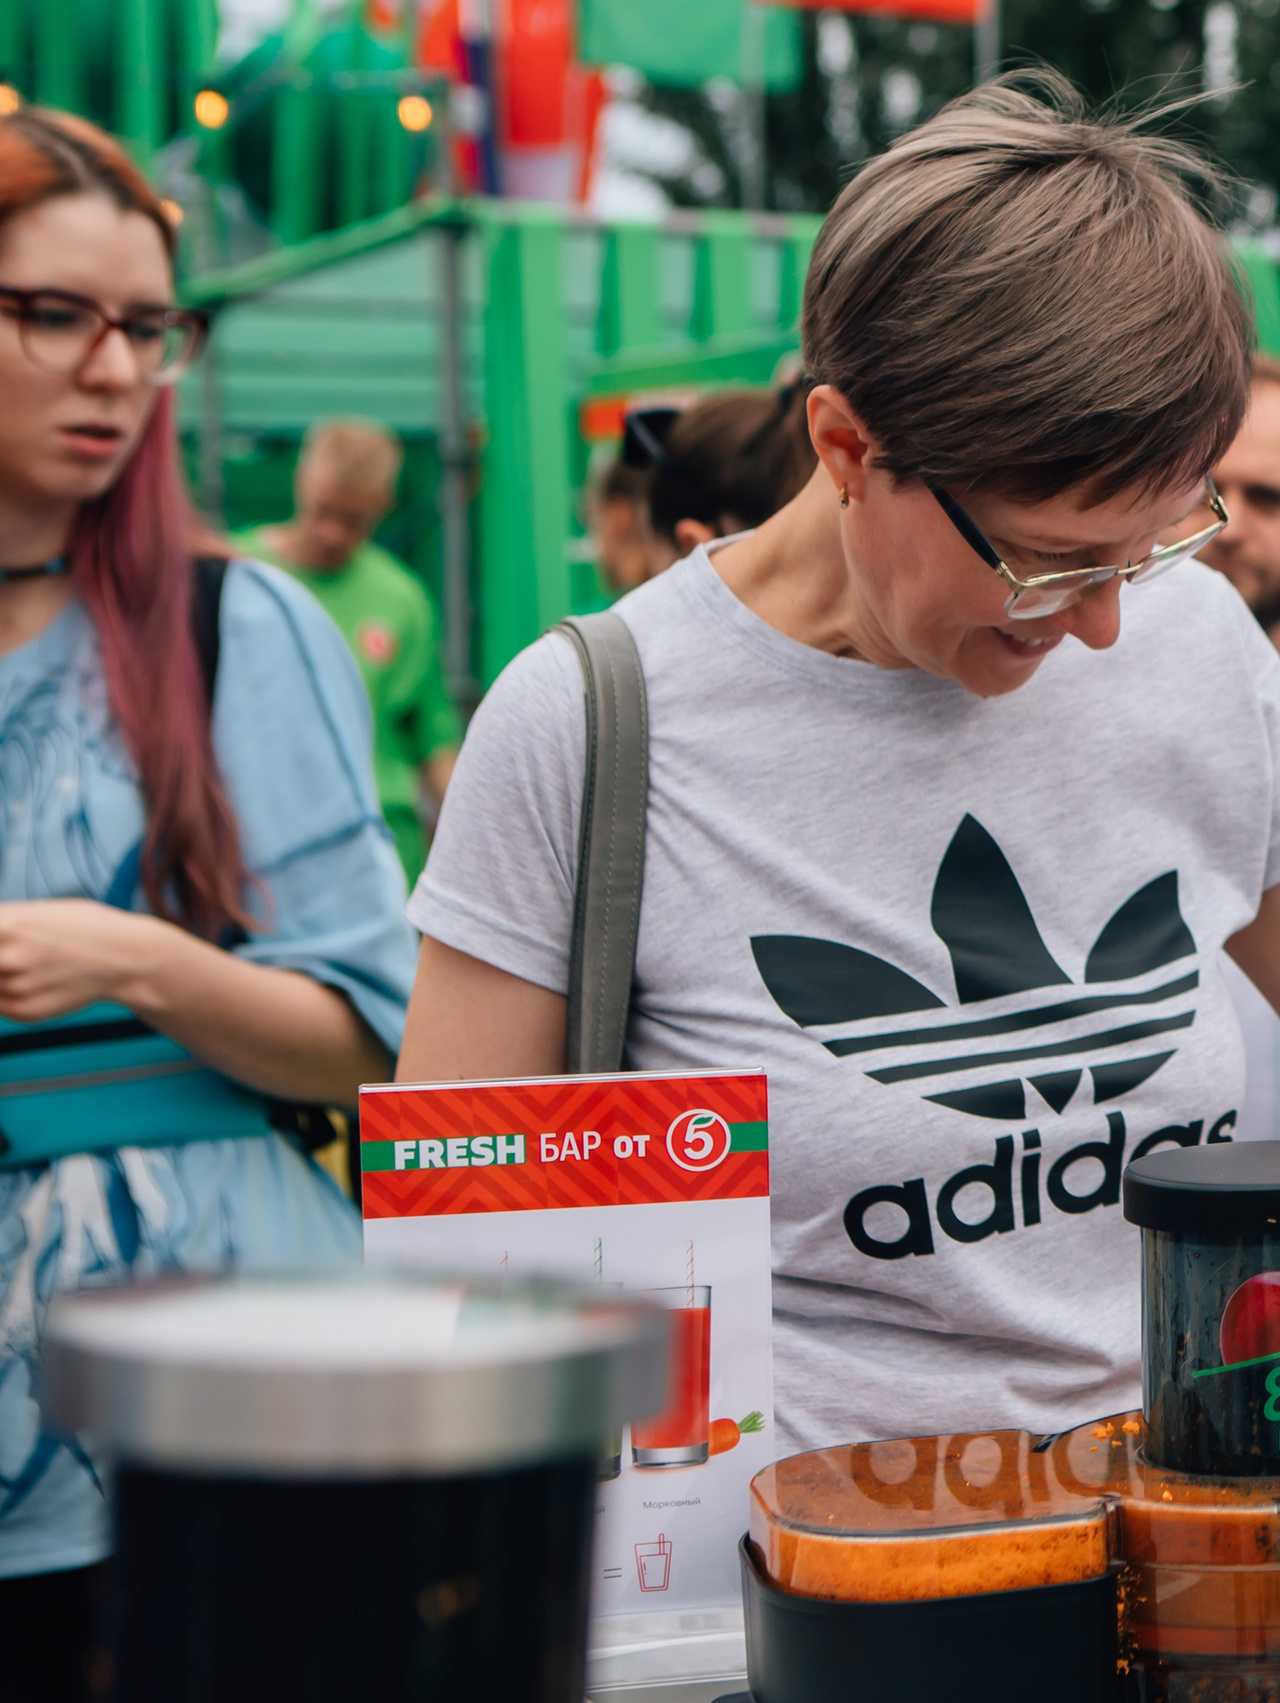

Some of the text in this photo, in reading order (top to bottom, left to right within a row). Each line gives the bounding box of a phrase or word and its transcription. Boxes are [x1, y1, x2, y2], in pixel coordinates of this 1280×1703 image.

[394, 1134, 526, 1170] FRESH
[539, 1131, 602, 1163] БАР
[612, 1134, 651, 1159] от
[642, 1496, 702, 1510] Морковный
